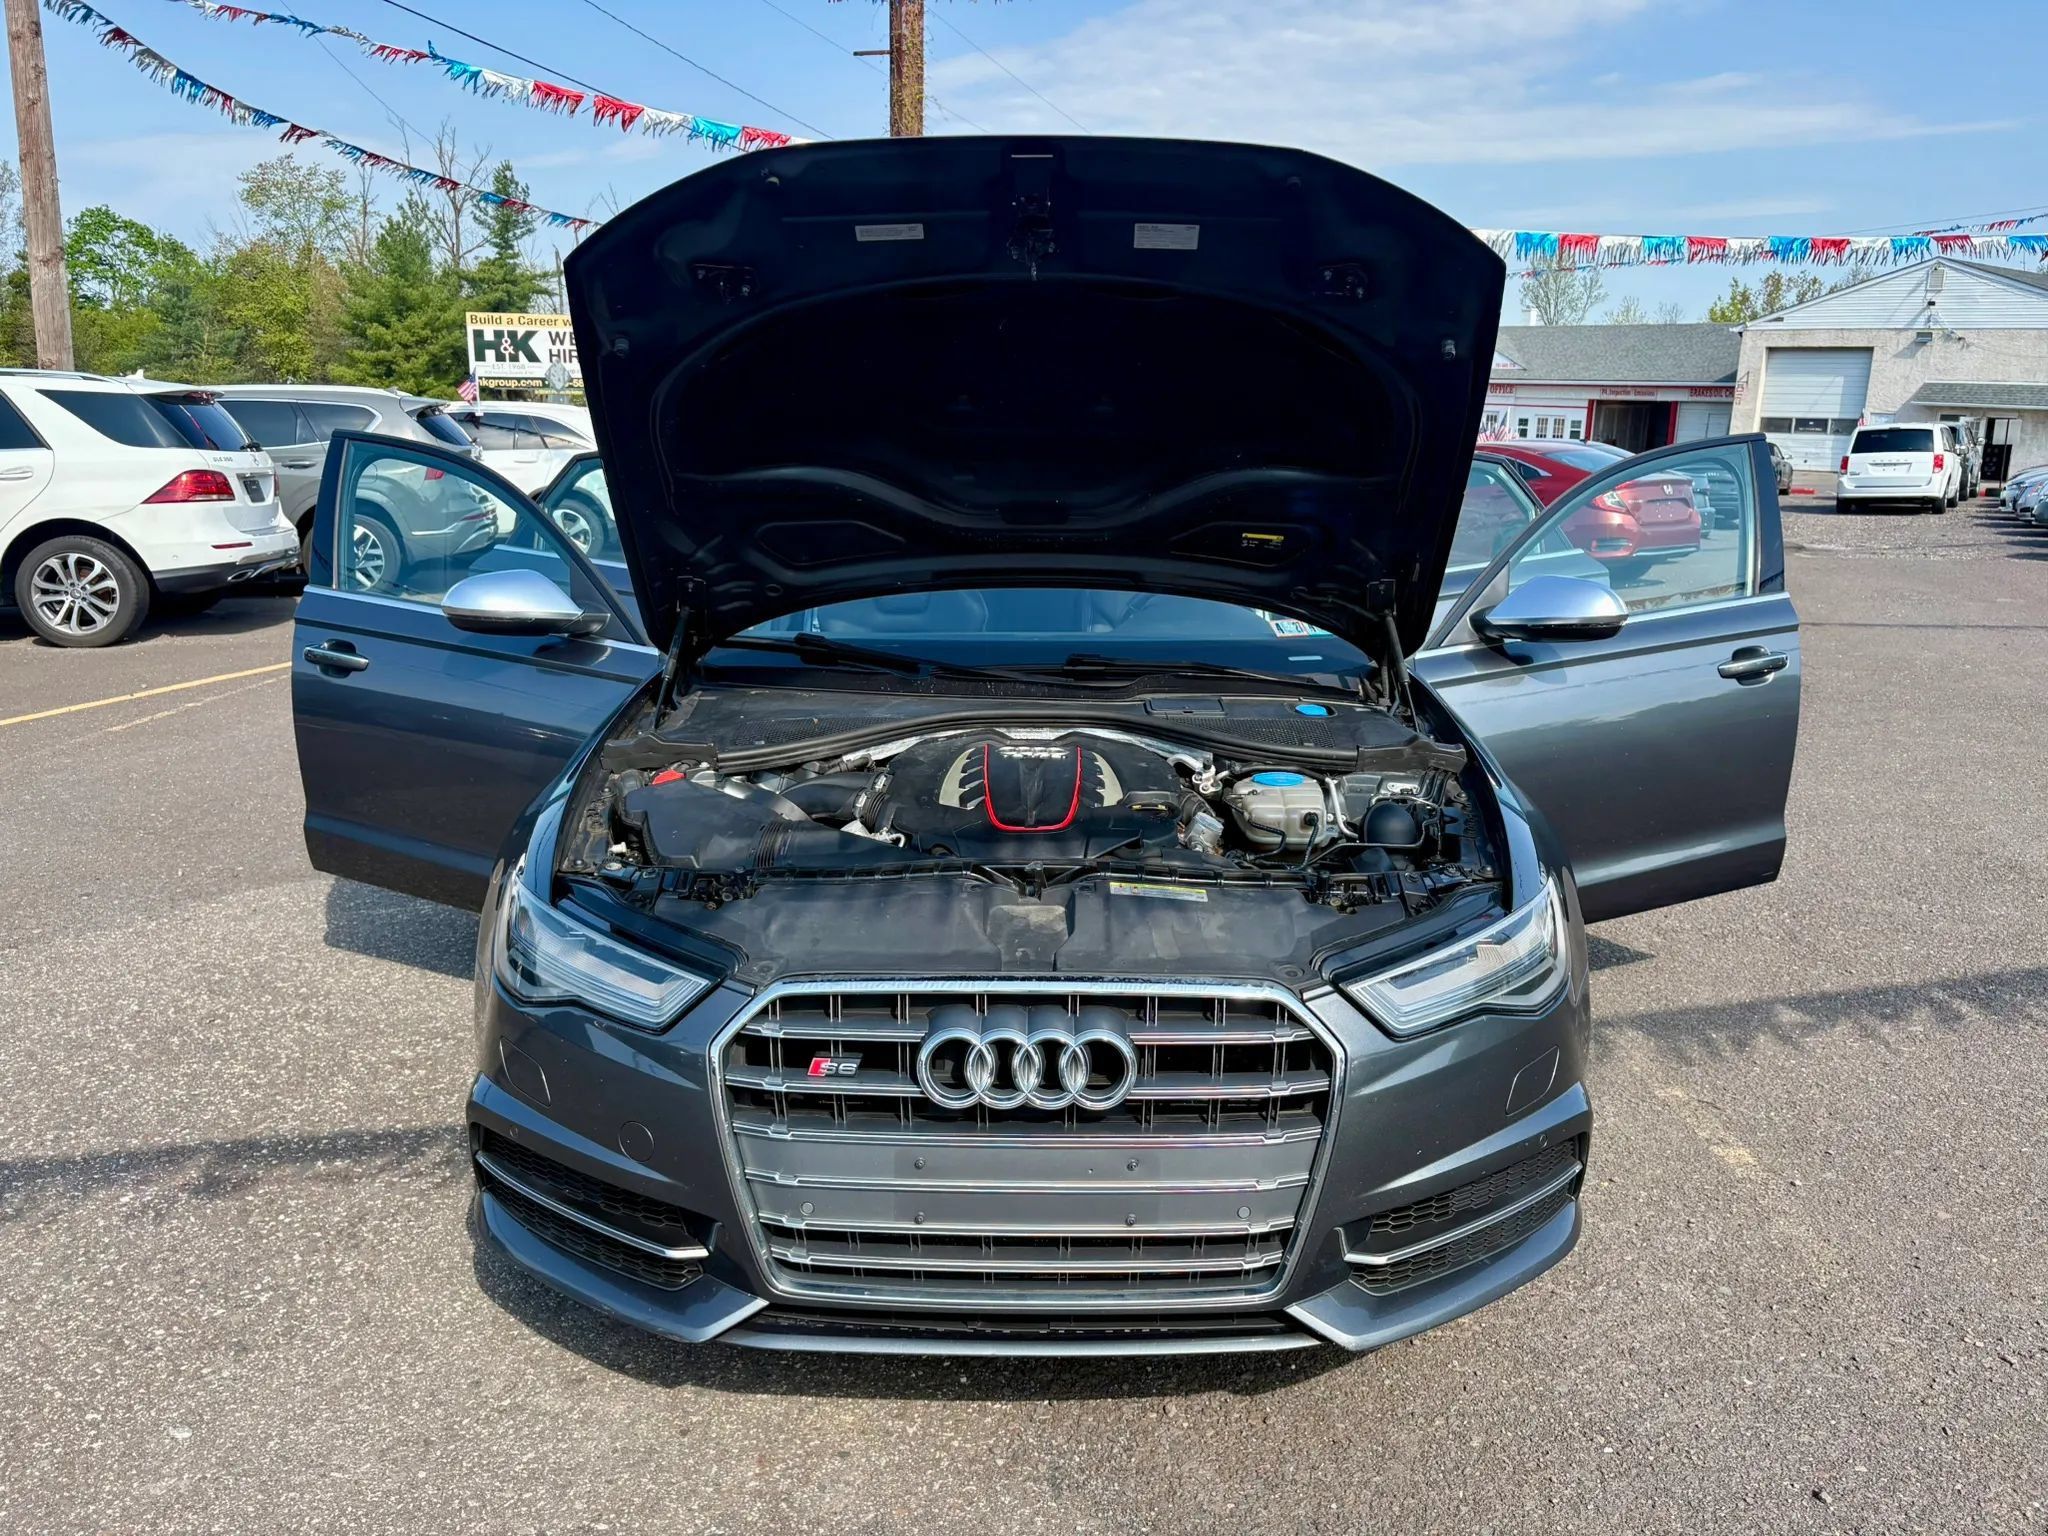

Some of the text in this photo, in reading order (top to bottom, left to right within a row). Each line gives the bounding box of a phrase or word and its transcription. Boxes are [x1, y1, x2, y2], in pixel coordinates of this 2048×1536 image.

[470, 314, 502, 325] Build
[506, 317, 513, 325] a
[518, 315, 557, 327] Career
[472, 329, 542, 362] H&K
[1489, 384, 1514, 394] OFFICE
[819, 1062, 857, 1074] S6
